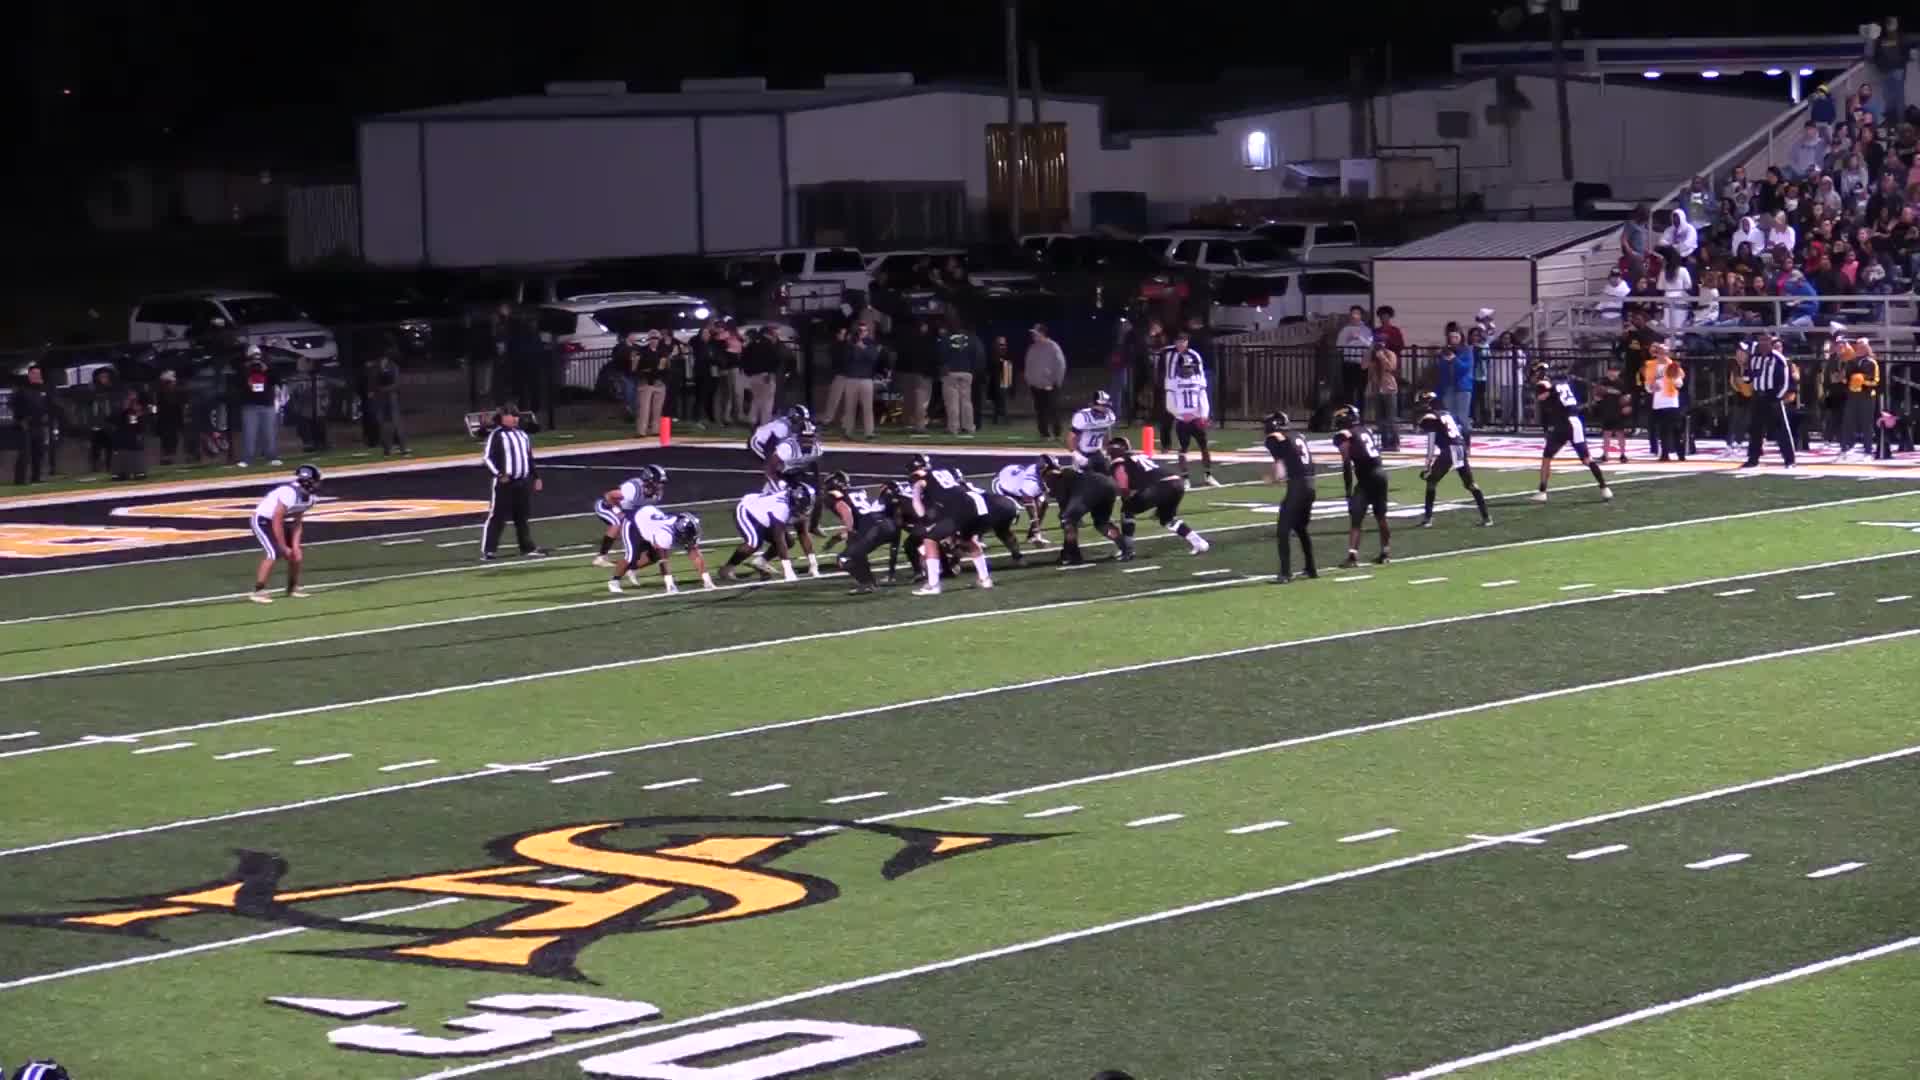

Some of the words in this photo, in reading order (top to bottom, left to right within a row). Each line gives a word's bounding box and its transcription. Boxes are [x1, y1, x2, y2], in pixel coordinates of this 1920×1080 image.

[1182, 389, 1194, 408] 11
[1295, 438, 1309, 465] 3
[326, 994, 922, 1080] 30
